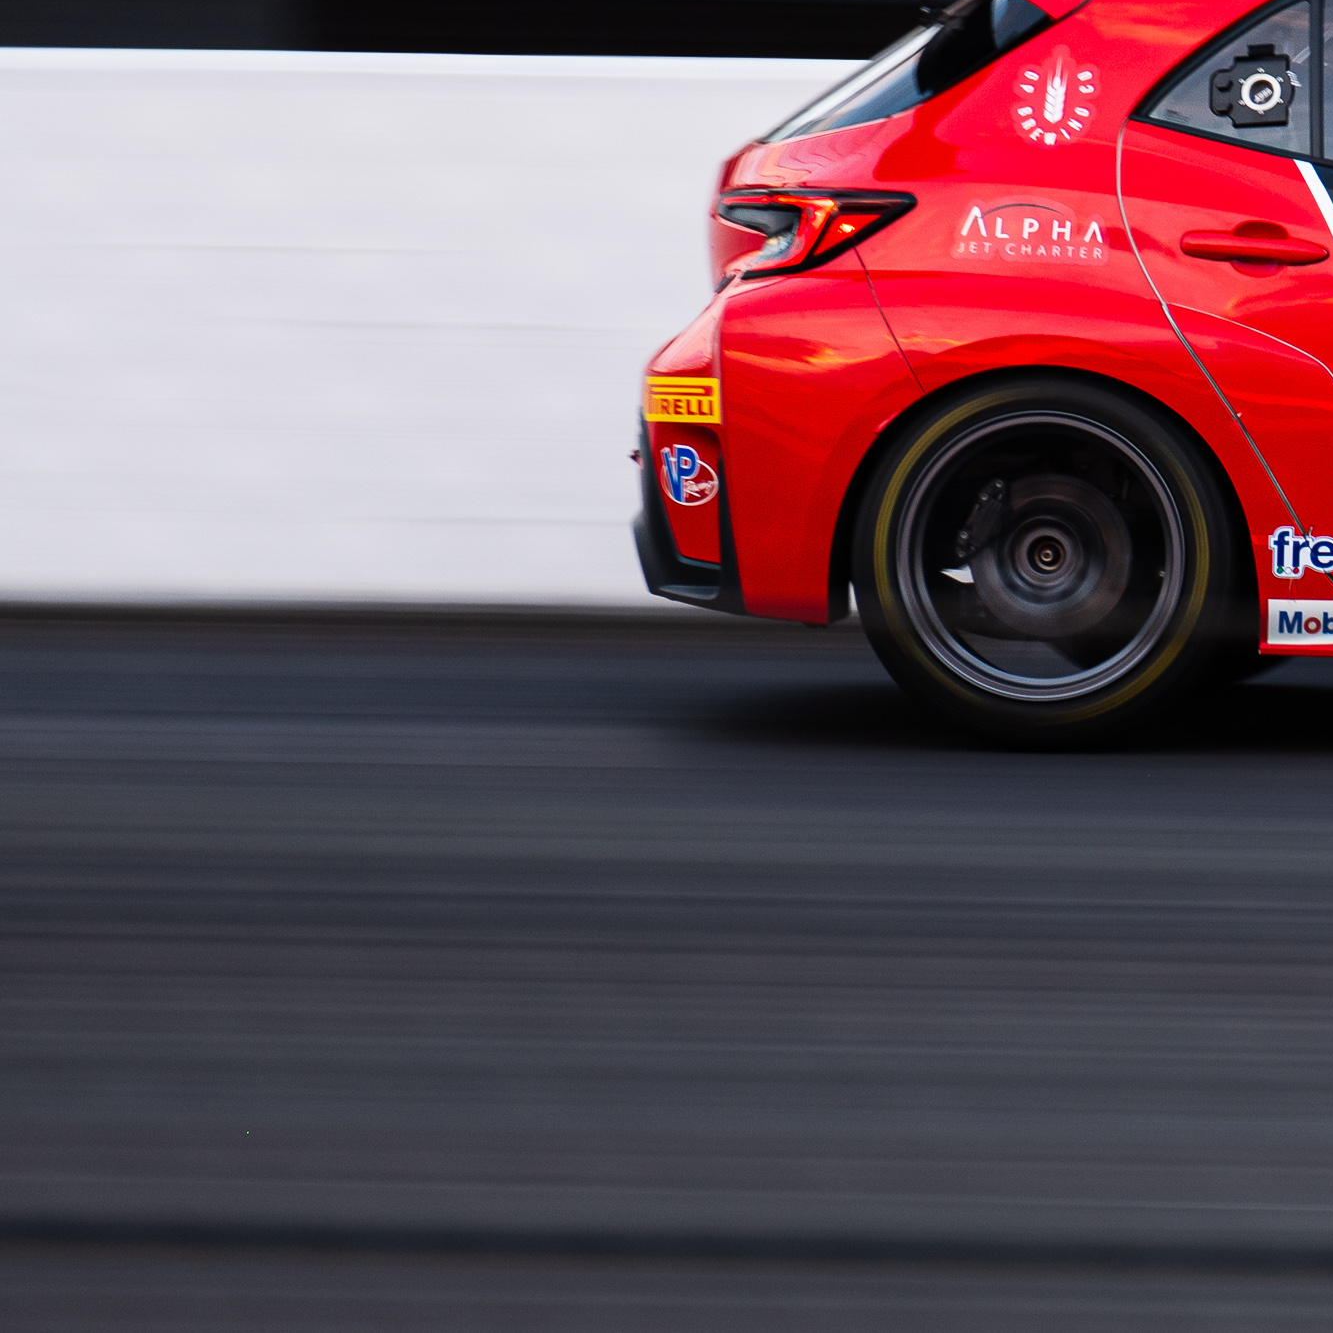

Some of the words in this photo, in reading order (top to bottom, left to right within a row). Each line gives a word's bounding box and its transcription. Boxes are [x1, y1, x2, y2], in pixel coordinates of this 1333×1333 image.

[960, 205, 1103, 243] ALPHA
[957, 241, 992, 254] JET
[1005, 242, 1103, 260] CHARTER
[661, 443, 699, 504] VP
